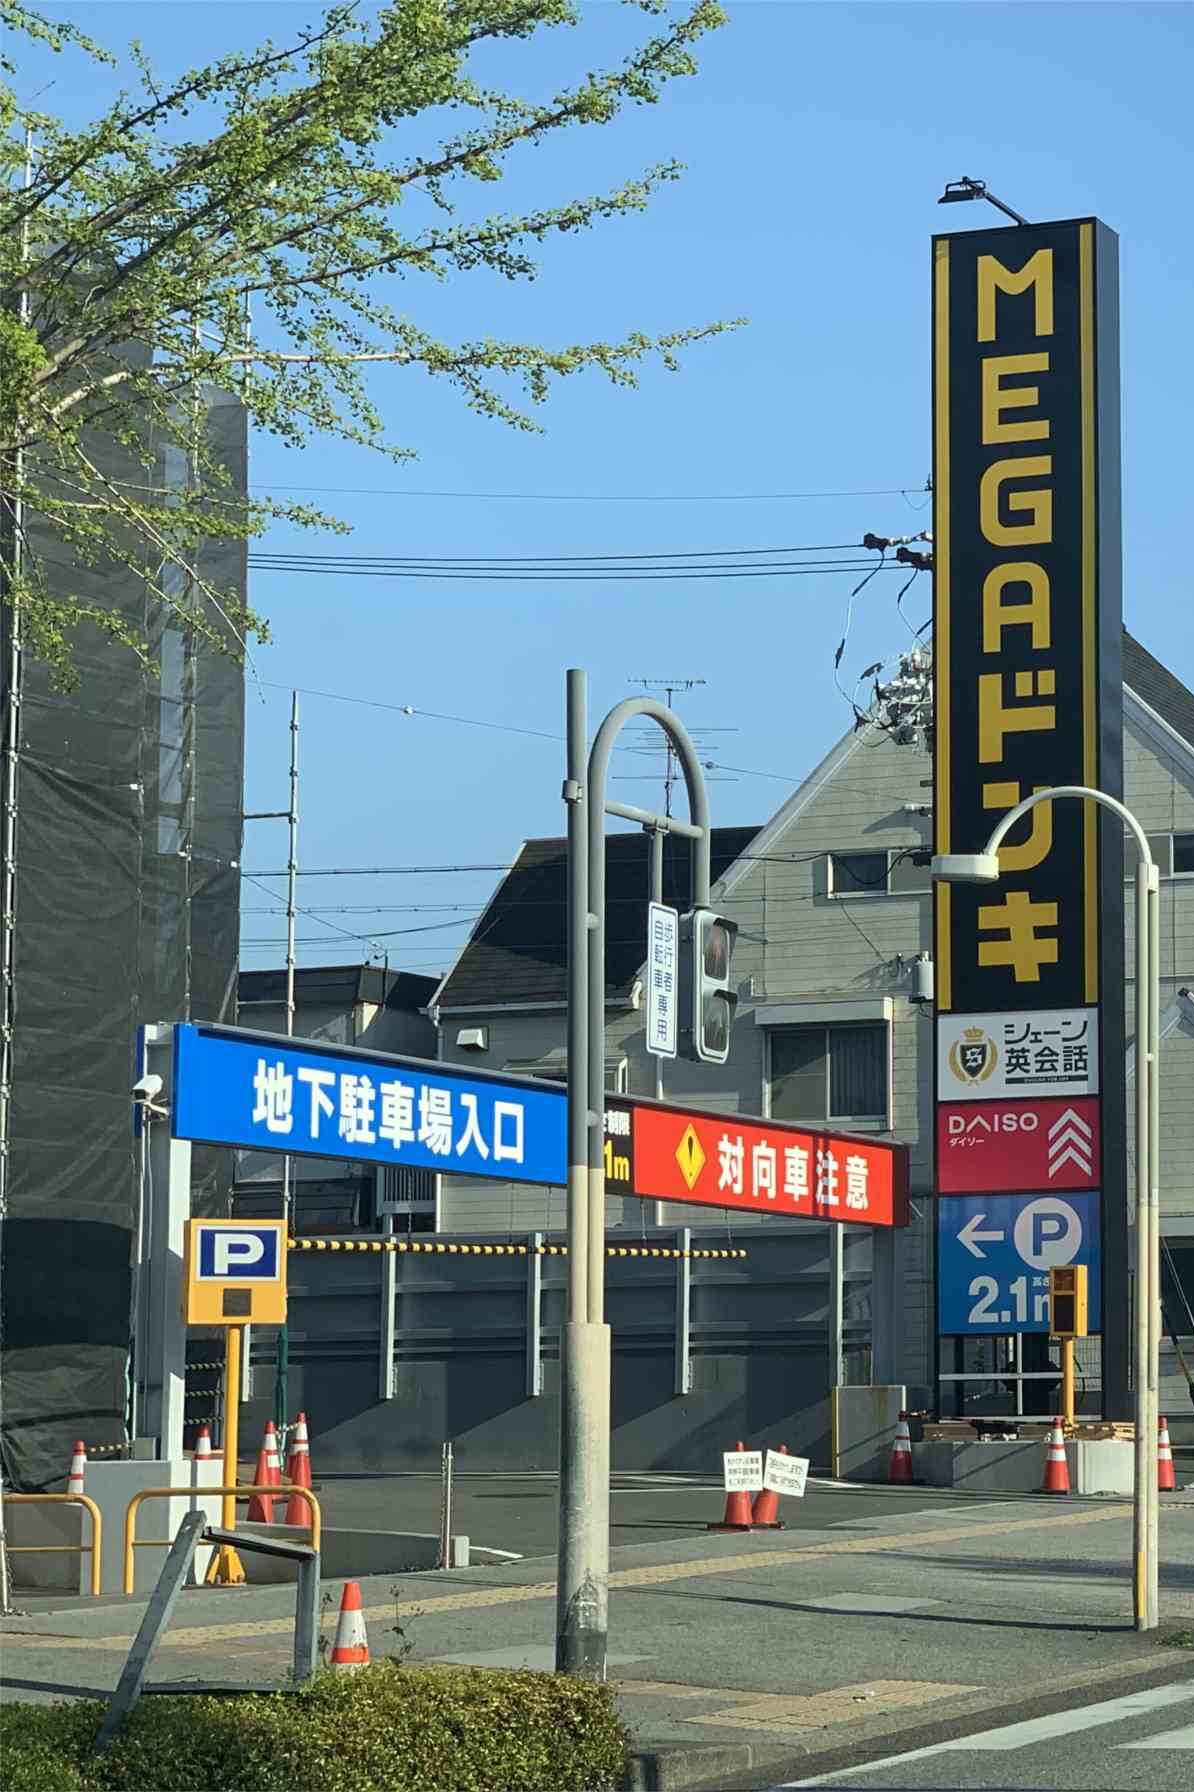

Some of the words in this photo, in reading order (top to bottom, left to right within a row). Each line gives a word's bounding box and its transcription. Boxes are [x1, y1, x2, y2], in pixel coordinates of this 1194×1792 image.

[977, 248, 1059, 983] MEGAドンキ
[1003, 1019, 1089, 1044] シェーン
[1004, 1045, 1089, 1075] 英会話
[251, 1057, 526, 1165] 地下駐車場入口
[948, 1112, 1039, 1134] DAISO
[949, 1137, 985, 1147] ダイソー
[717, 1131, 870, 1212] 対向車注意
[213, 1233, 265, 1275] P
[1032, 1212, 1069, 1257] P
